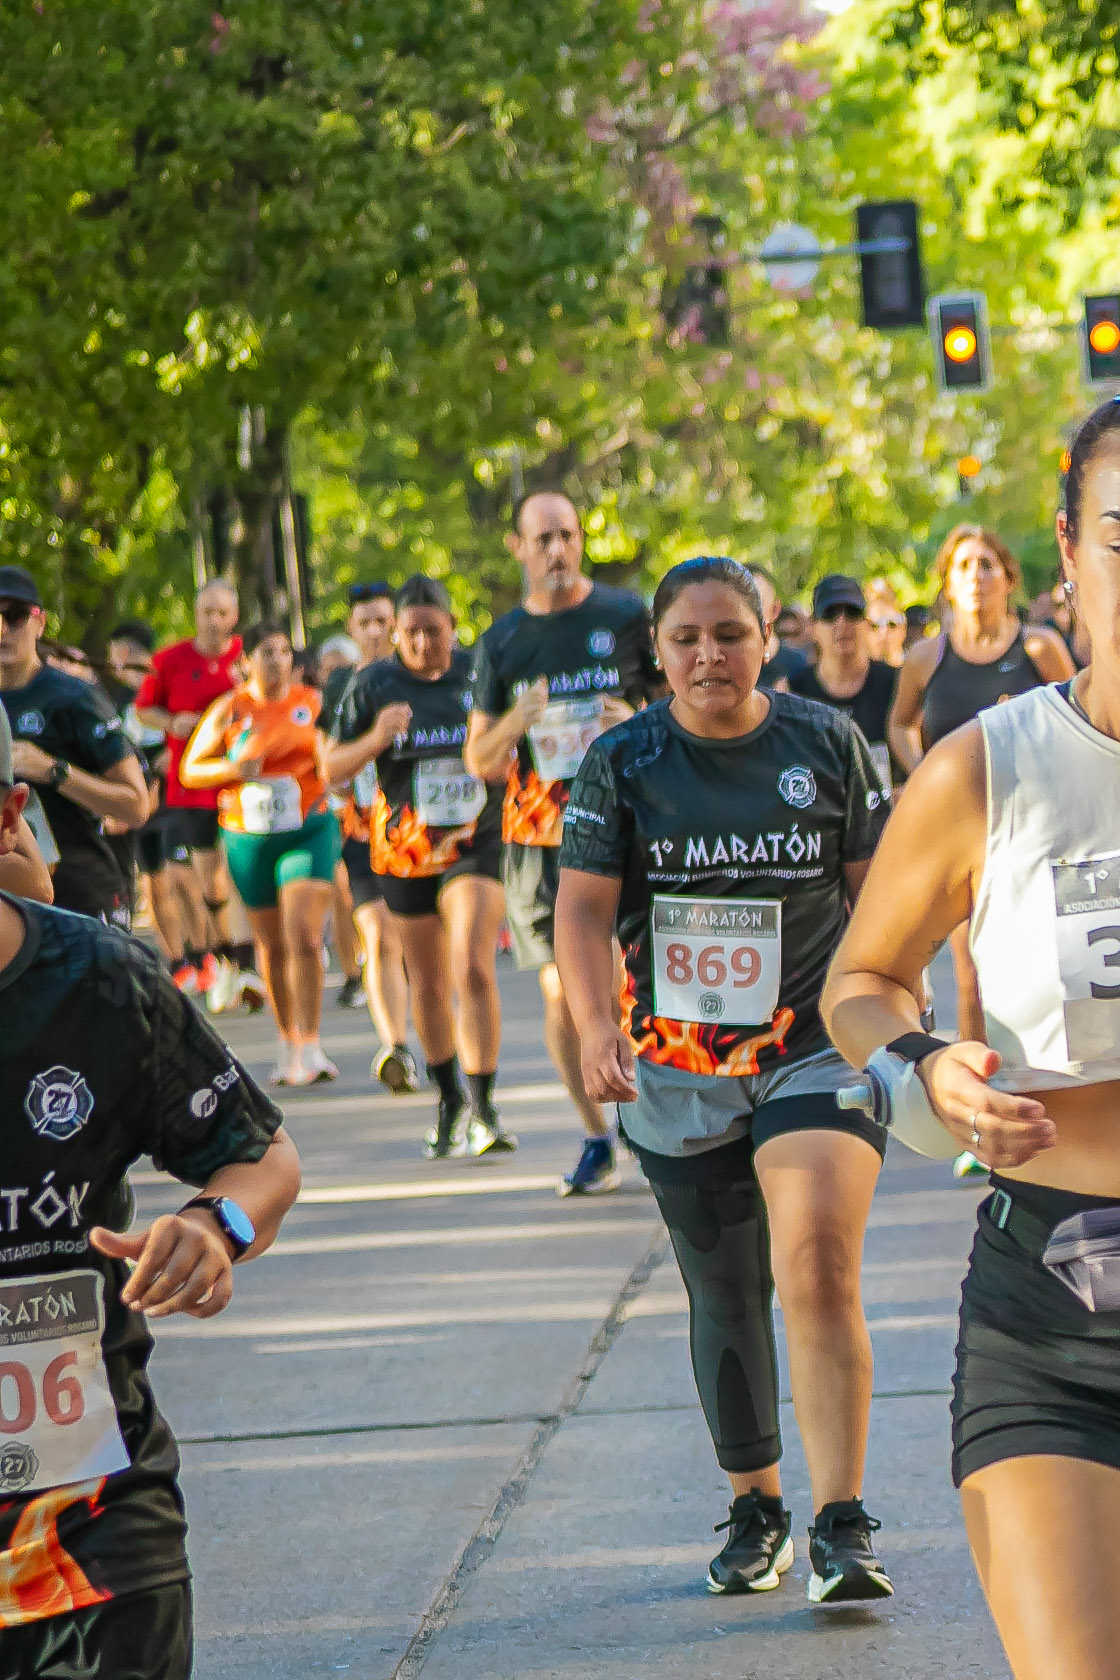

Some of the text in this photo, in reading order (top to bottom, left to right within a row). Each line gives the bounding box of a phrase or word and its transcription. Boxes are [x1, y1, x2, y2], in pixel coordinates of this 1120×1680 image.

[685, 822, 822, 868] MARATÓN
[685, 907, 763, 928] MARATÓN
[666, 943, 762, 989] 869
[47, 1088, 73, 1117] 27
[0, 1171, 90, 1232] TÓN
